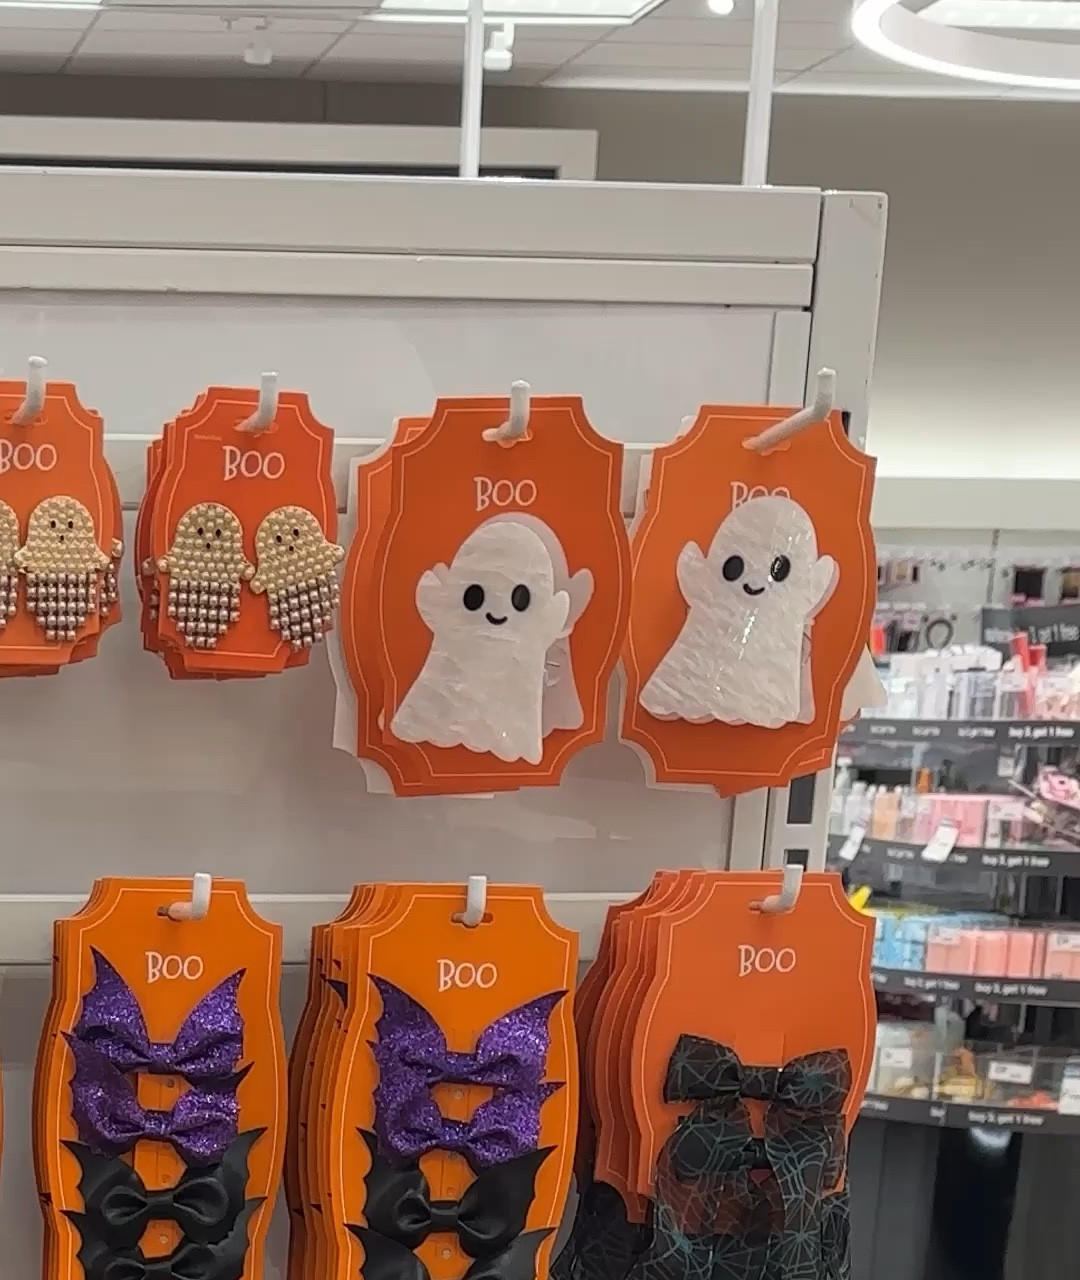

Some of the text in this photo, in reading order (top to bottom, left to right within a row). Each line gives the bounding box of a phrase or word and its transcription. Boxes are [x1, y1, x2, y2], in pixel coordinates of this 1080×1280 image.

[222, 445, 286, 481] BOO
[473, 477, 537, 513] BOO
[145, 951, 204, 984] BOO
[437, 959, 498, 992] BOO
[737, 944, 797, 977] BOO
